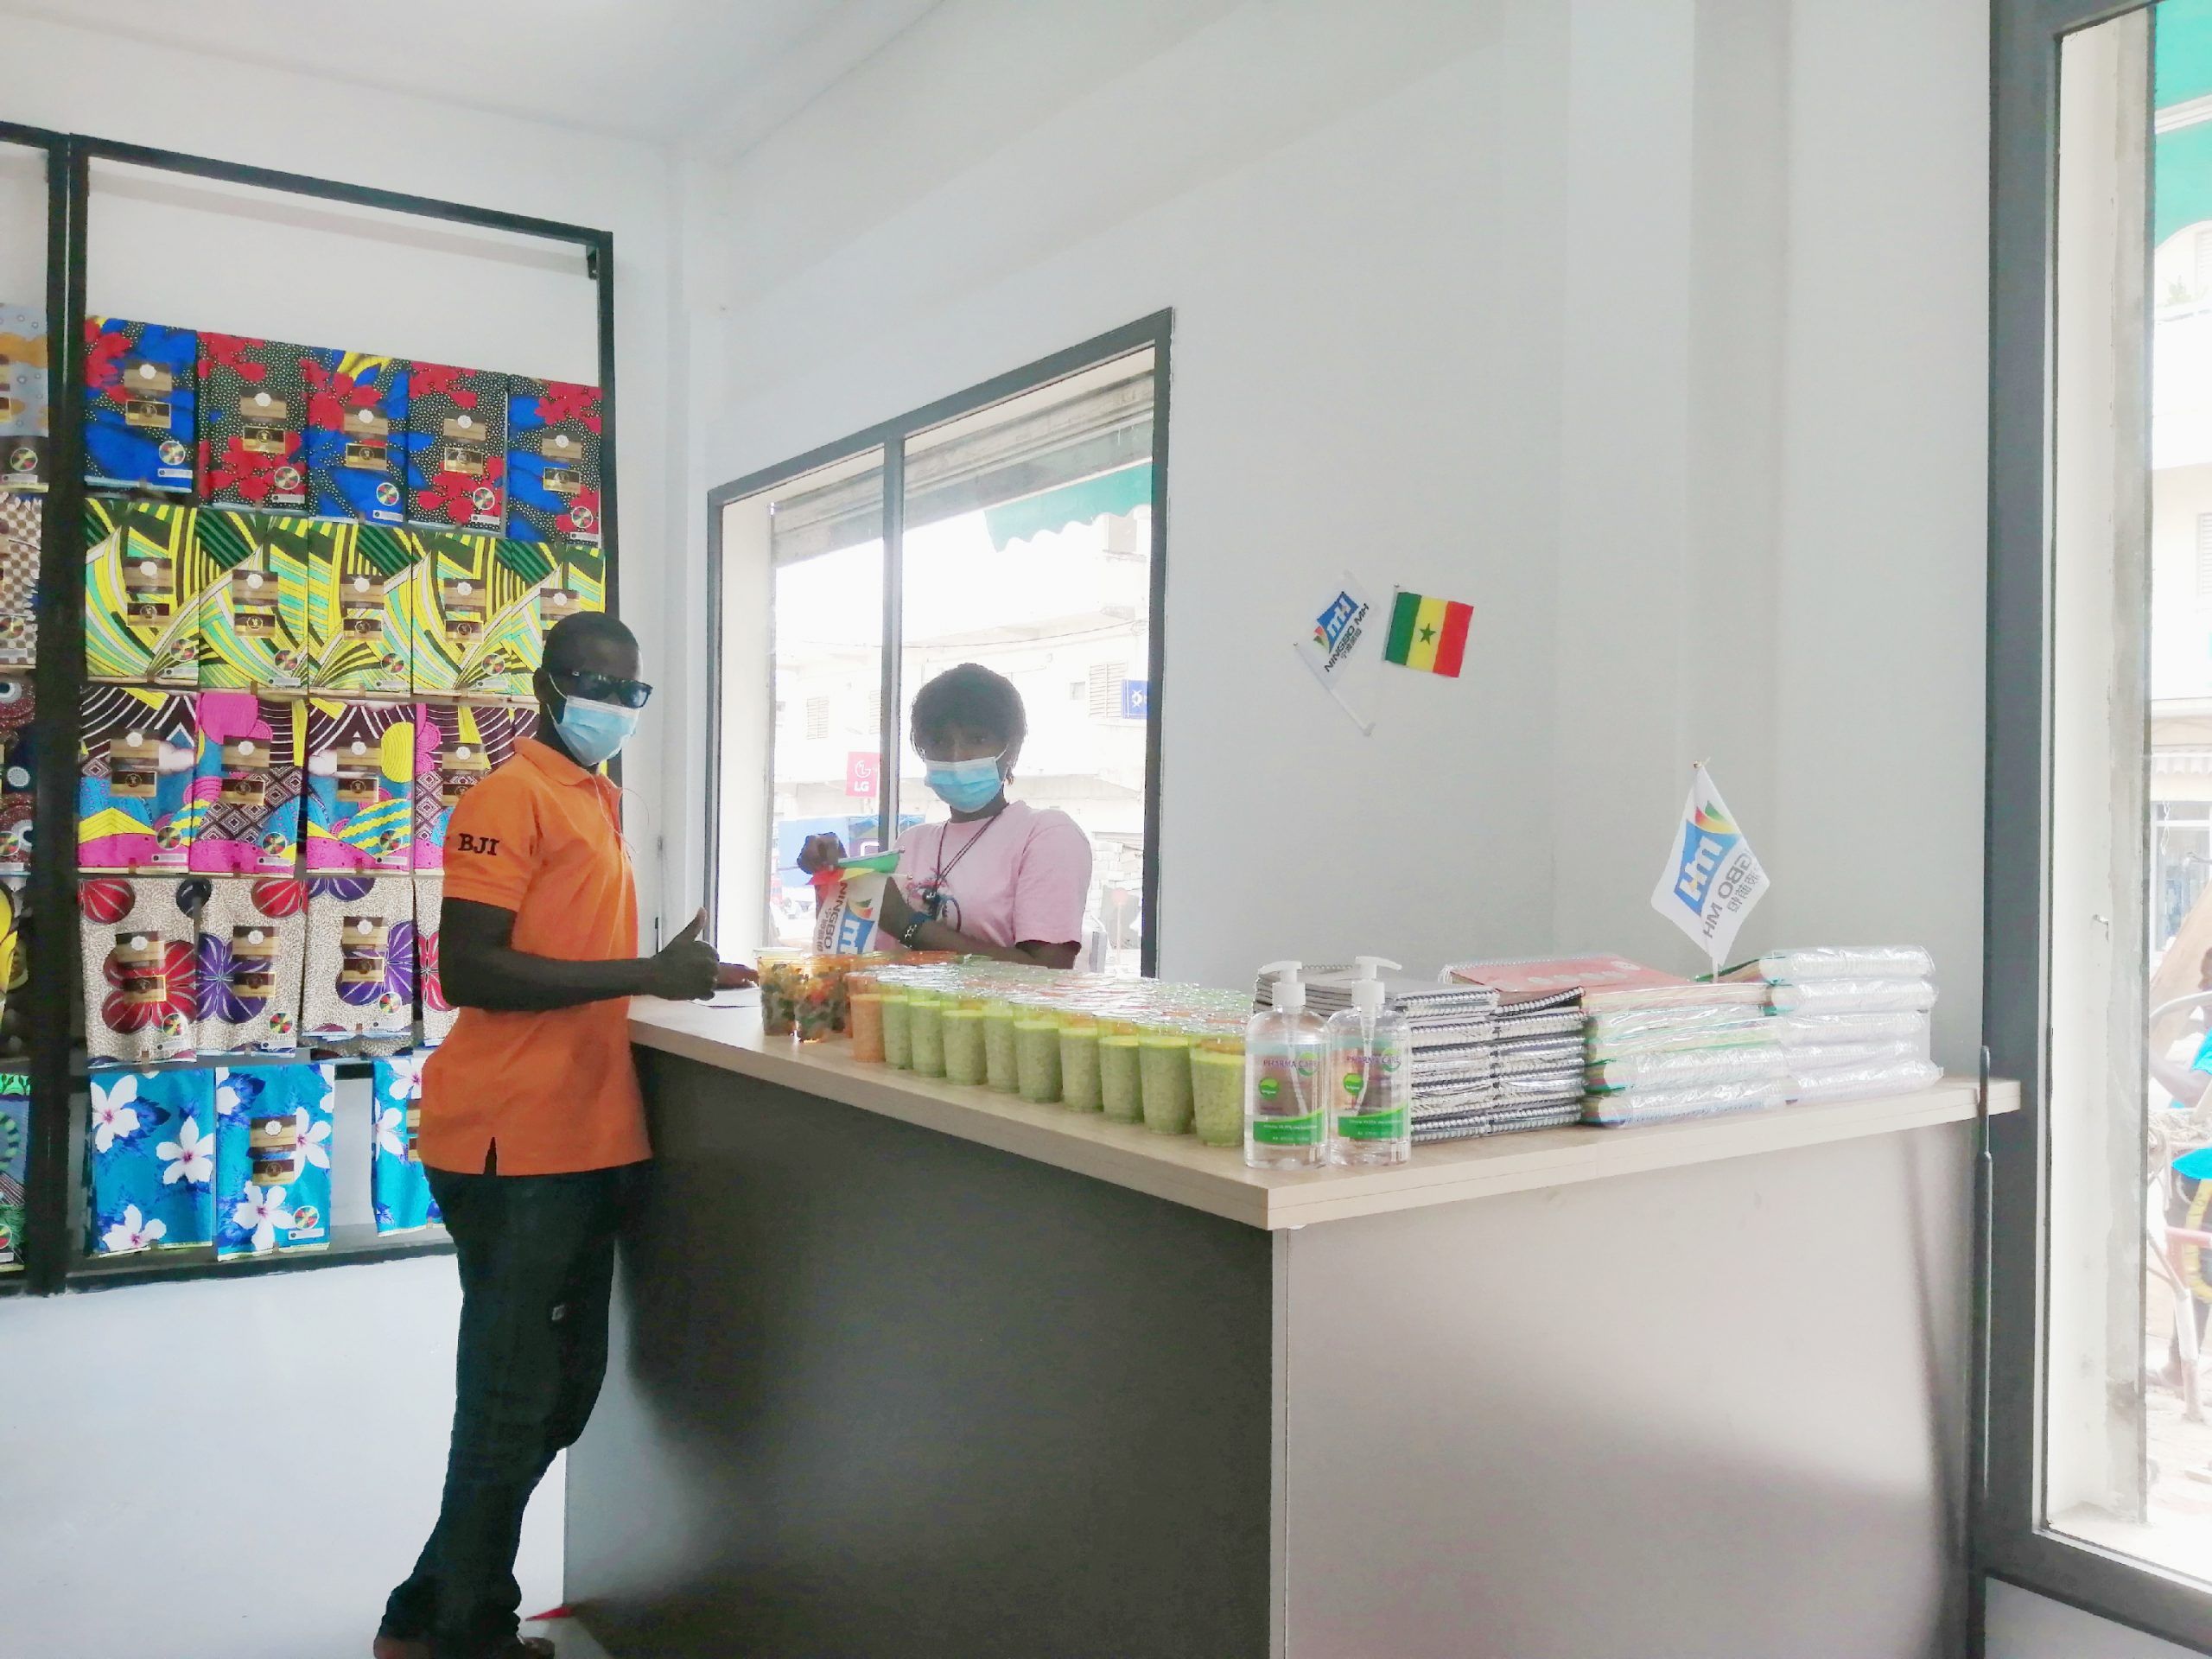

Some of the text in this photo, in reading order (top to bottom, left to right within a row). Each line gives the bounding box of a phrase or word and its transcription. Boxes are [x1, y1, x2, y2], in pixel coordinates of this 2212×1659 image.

[1324, 602, 1370, 672] NINGBO MH
[854, 780, 870, 792] LG
[458, 833, 500, 855] BJI
[824, 881, 849, 949] NINGBO
[1263, 1059, 1296, 1068] PHARMA
